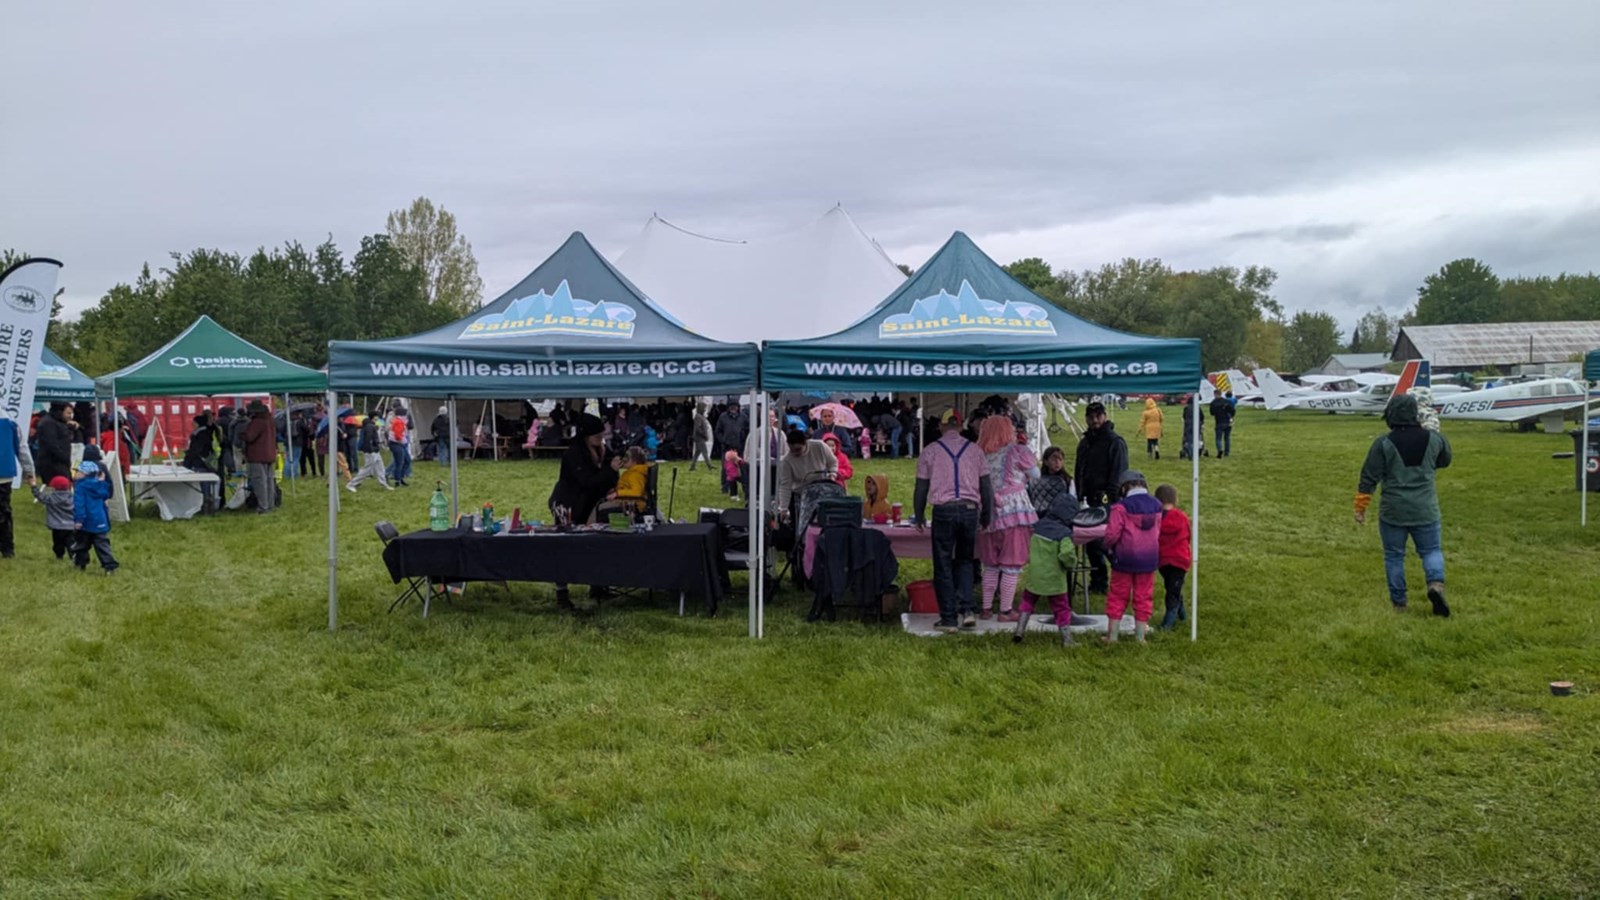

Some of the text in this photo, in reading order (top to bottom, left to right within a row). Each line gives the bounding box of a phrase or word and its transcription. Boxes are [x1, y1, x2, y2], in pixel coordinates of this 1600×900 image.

[469, 314, 632, 332] Saint-Lazare
[882, 314, 1050, 332] Saint-Lazare
[193, 356, 263, 365] Desjardins
[370, 359, 716, 378] www.ville.saint-lazare.qc.ca
[803, 360, 1159, 377] www.ville.saint-lazare.qc.ca
[1442, 400, 1493, 415] C-GESI
